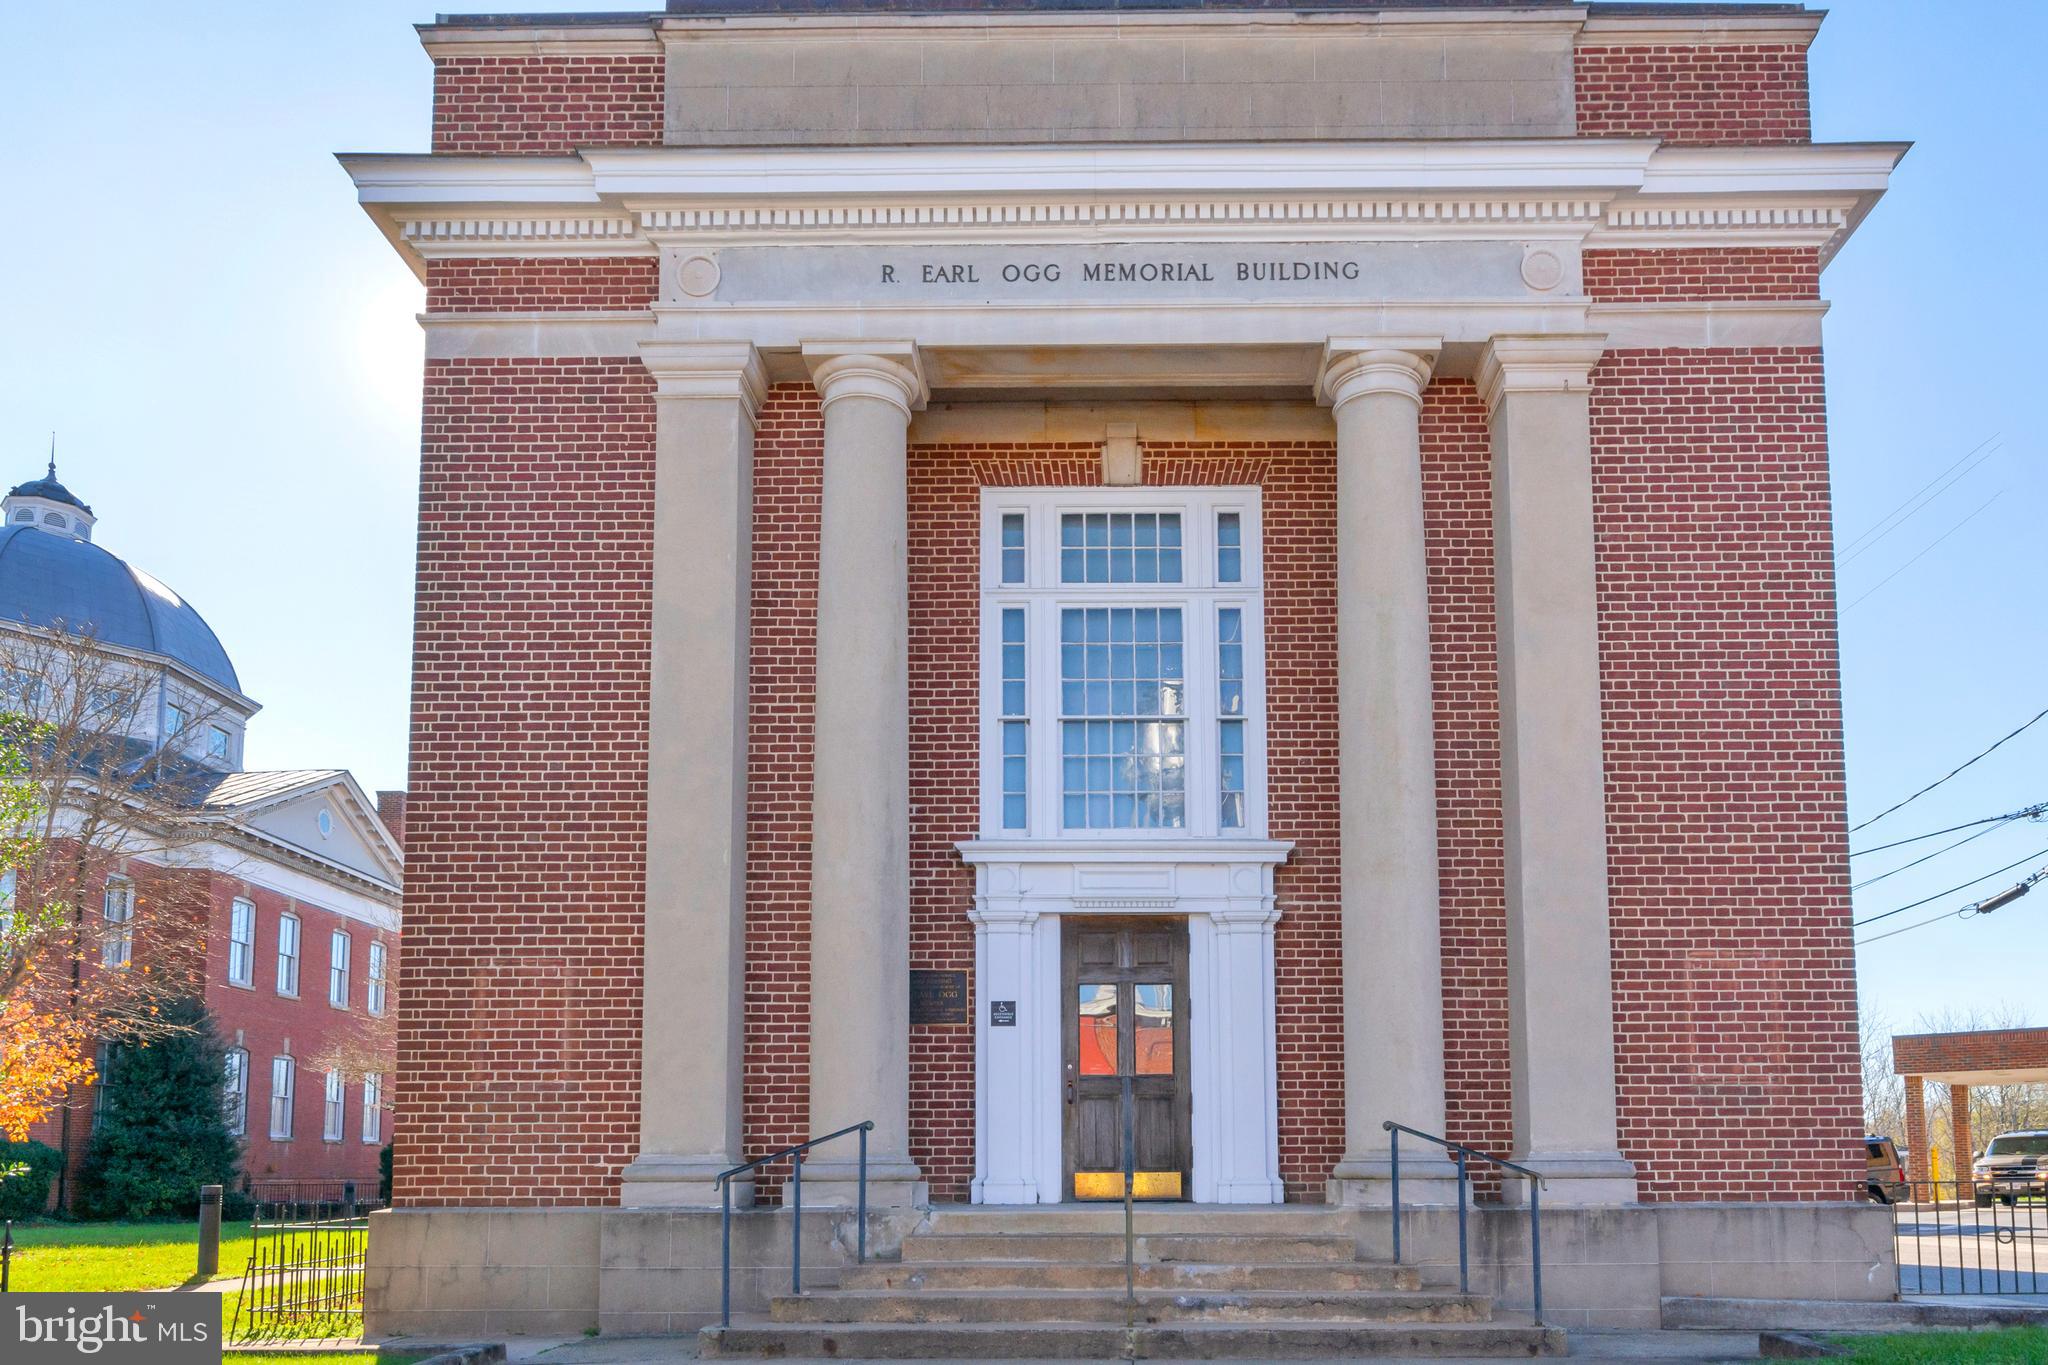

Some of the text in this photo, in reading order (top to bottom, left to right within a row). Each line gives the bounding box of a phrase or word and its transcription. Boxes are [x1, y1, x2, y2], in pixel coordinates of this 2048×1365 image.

[881, 261, 1360, 284] R. EARL OGG MEMORIAL BUILDING
